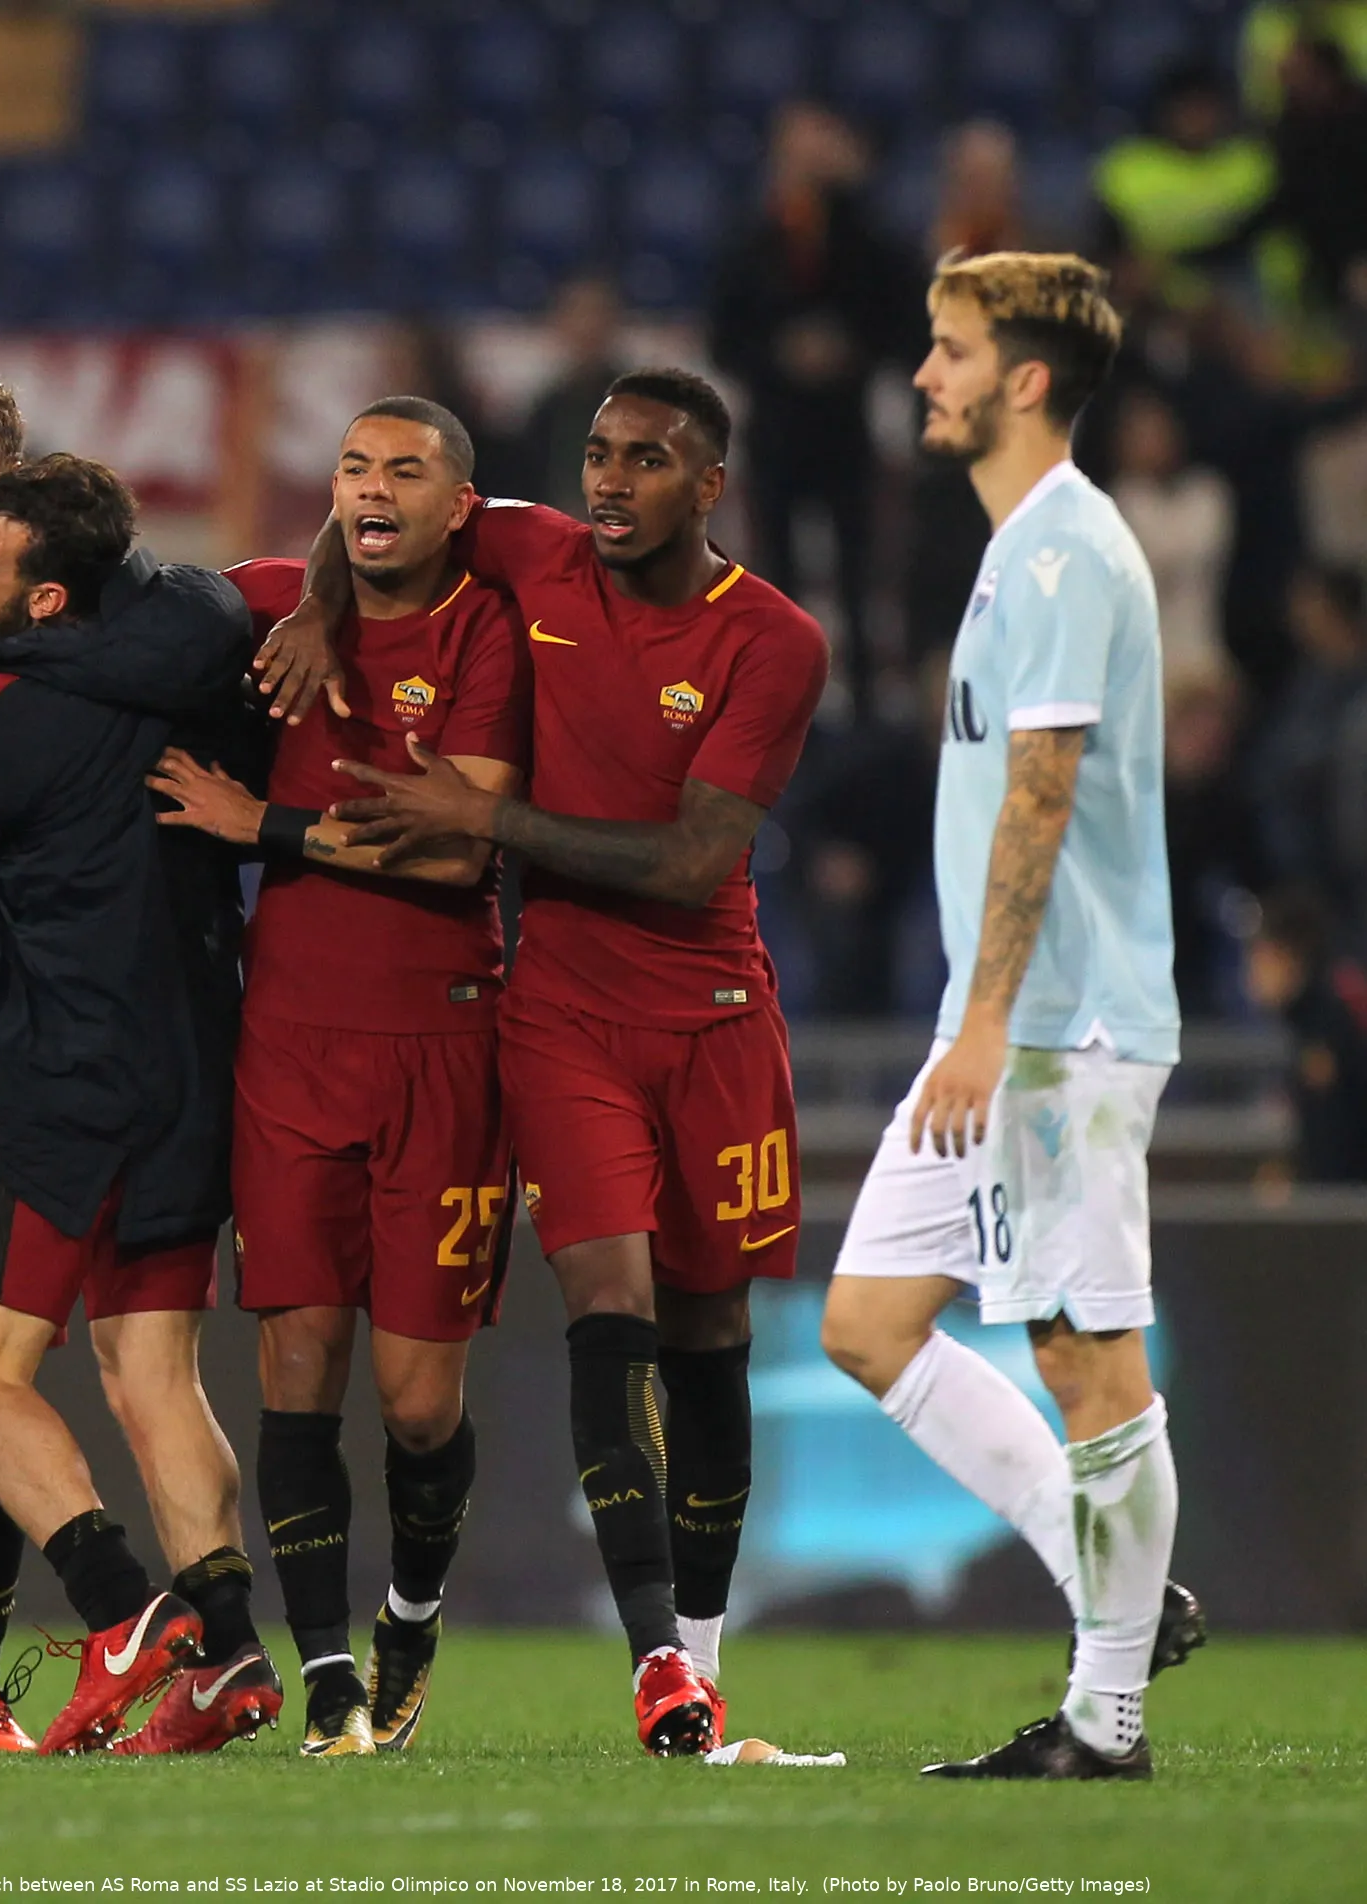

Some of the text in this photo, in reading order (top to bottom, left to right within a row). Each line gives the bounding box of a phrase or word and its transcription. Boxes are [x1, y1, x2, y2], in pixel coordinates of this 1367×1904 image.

[394, 703, 425, 717] ROMA
[663, 709, 694, 724] ROMA
[716, 1128, 791, 1221] 30
[437, 1186, 506, 1267] 25
[968, 1183, 1011, 1265] 18
